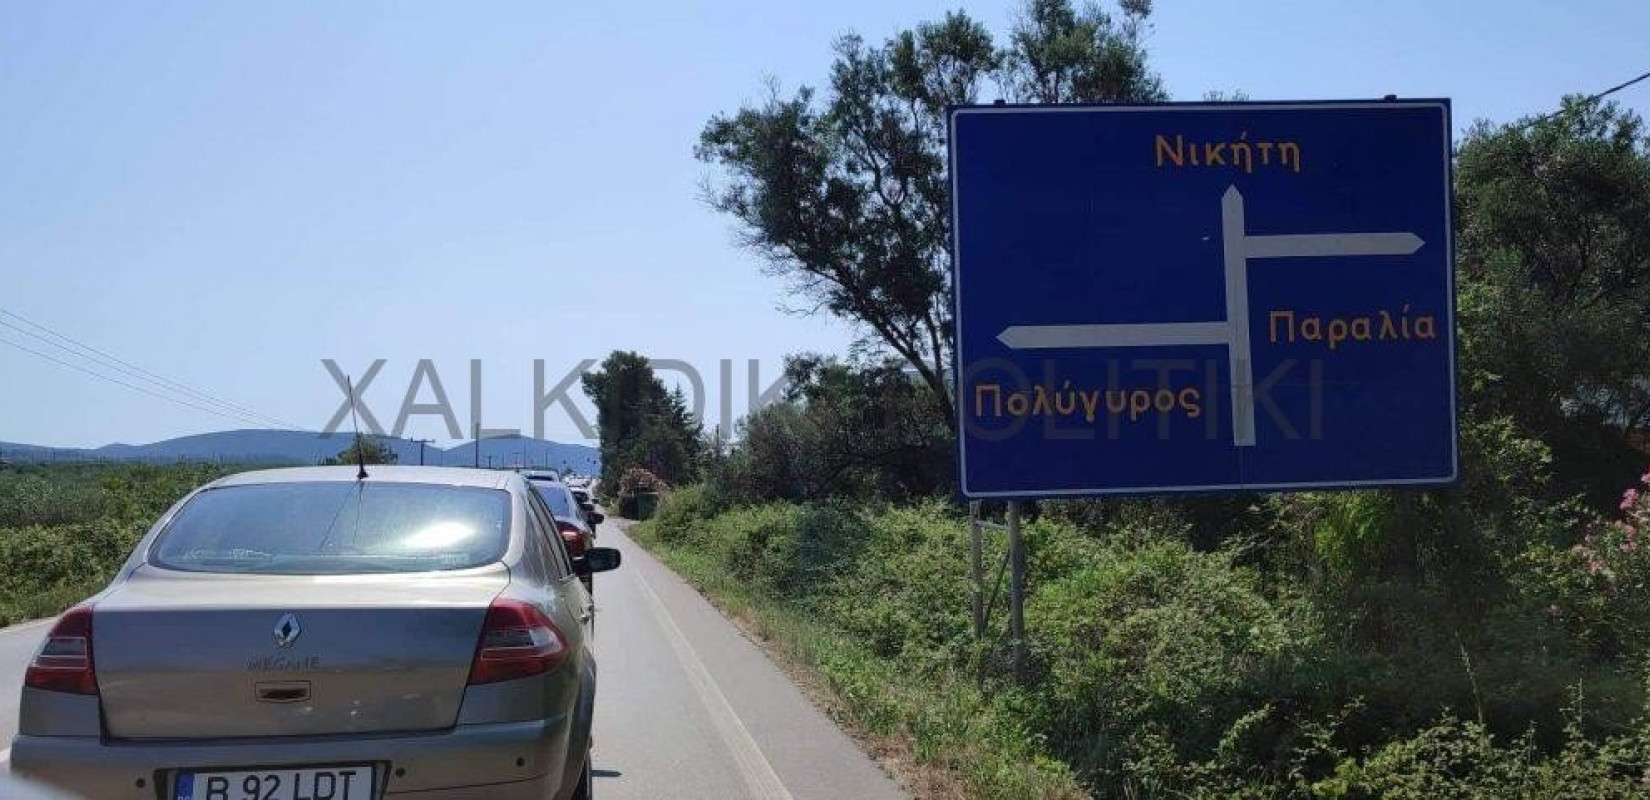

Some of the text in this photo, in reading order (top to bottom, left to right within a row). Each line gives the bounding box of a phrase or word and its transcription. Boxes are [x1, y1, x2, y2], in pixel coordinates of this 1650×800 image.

[1155, 132, 1301, 173] Νικήτη
[1268, 303, 1436, 350] Παραλία
[974, 381, 1201, 422] Πολύγυρος
[242, 774, 281, 800] 92
[293, 770, 357, 800] LDT
